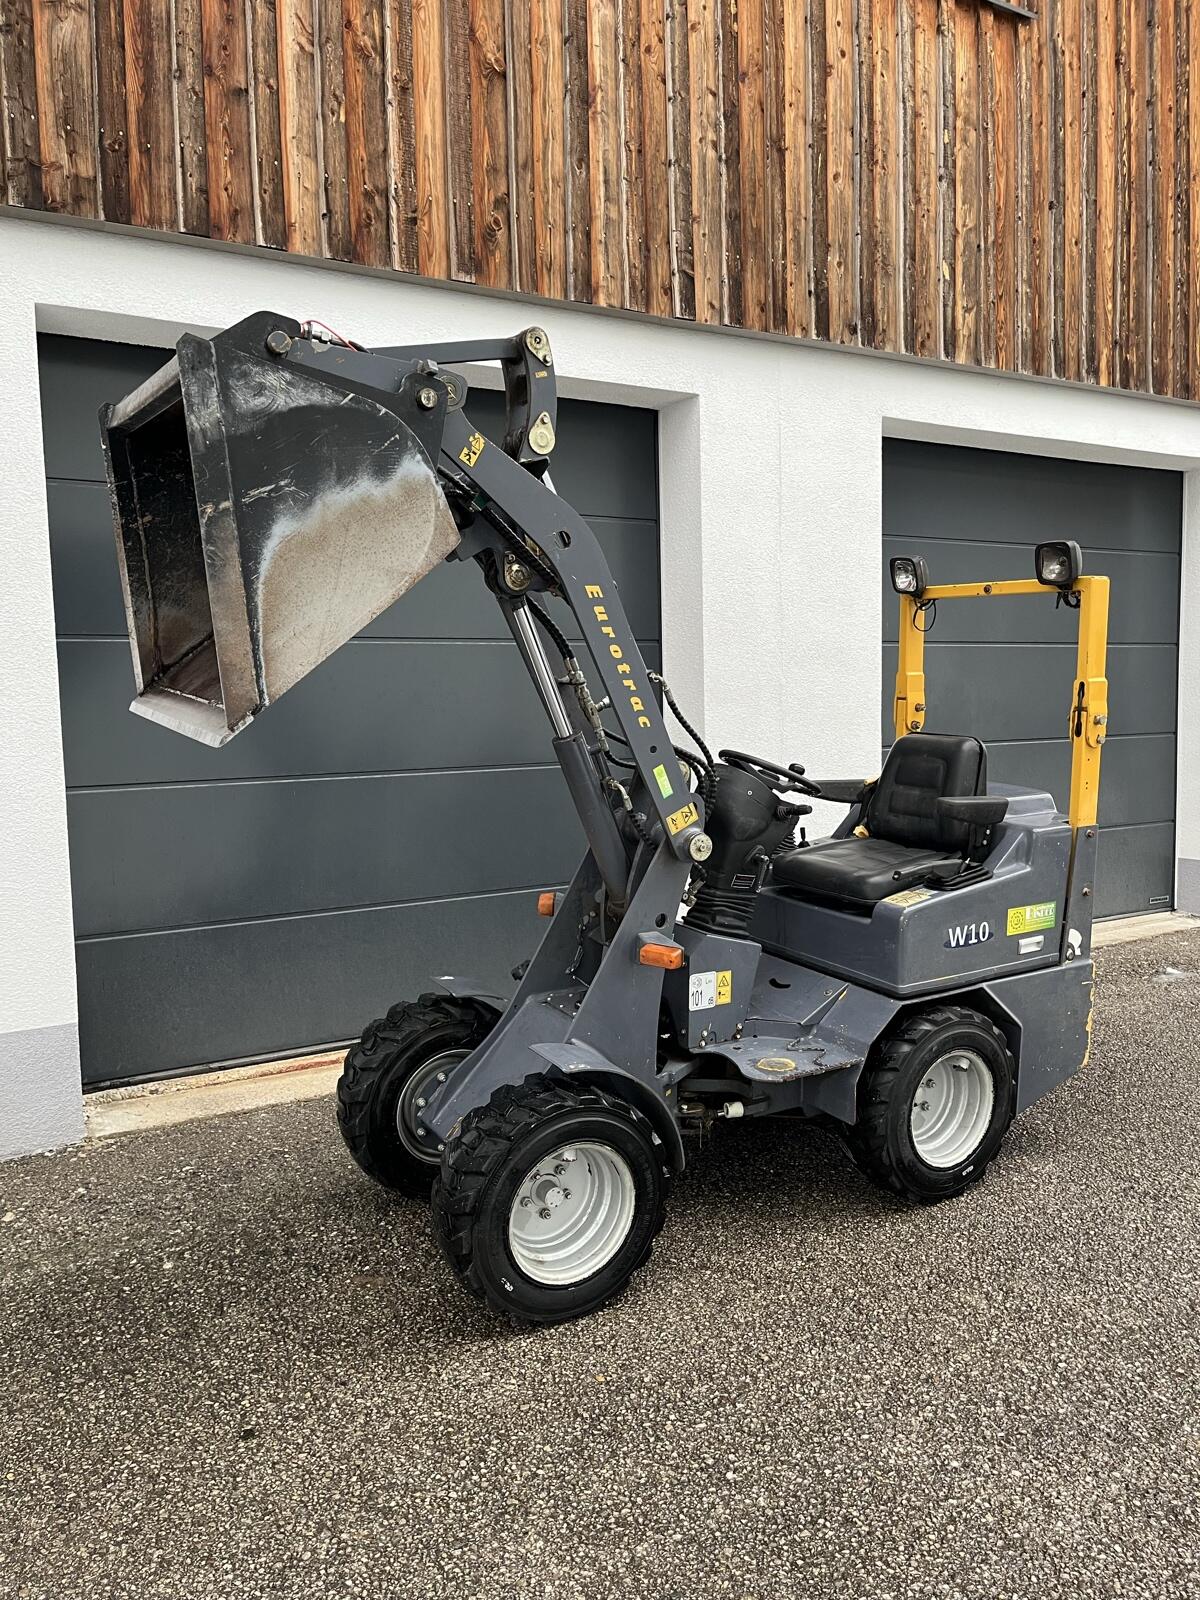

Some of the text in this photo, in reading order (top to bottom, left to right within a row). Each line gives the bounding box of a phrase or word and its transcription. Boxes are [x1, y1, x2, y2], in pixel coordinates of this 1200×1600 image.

[584, 584, 651, 728] Eurotrac
[948, 921, 990, 948] W10
[691, 990, 703, 1007] 101
